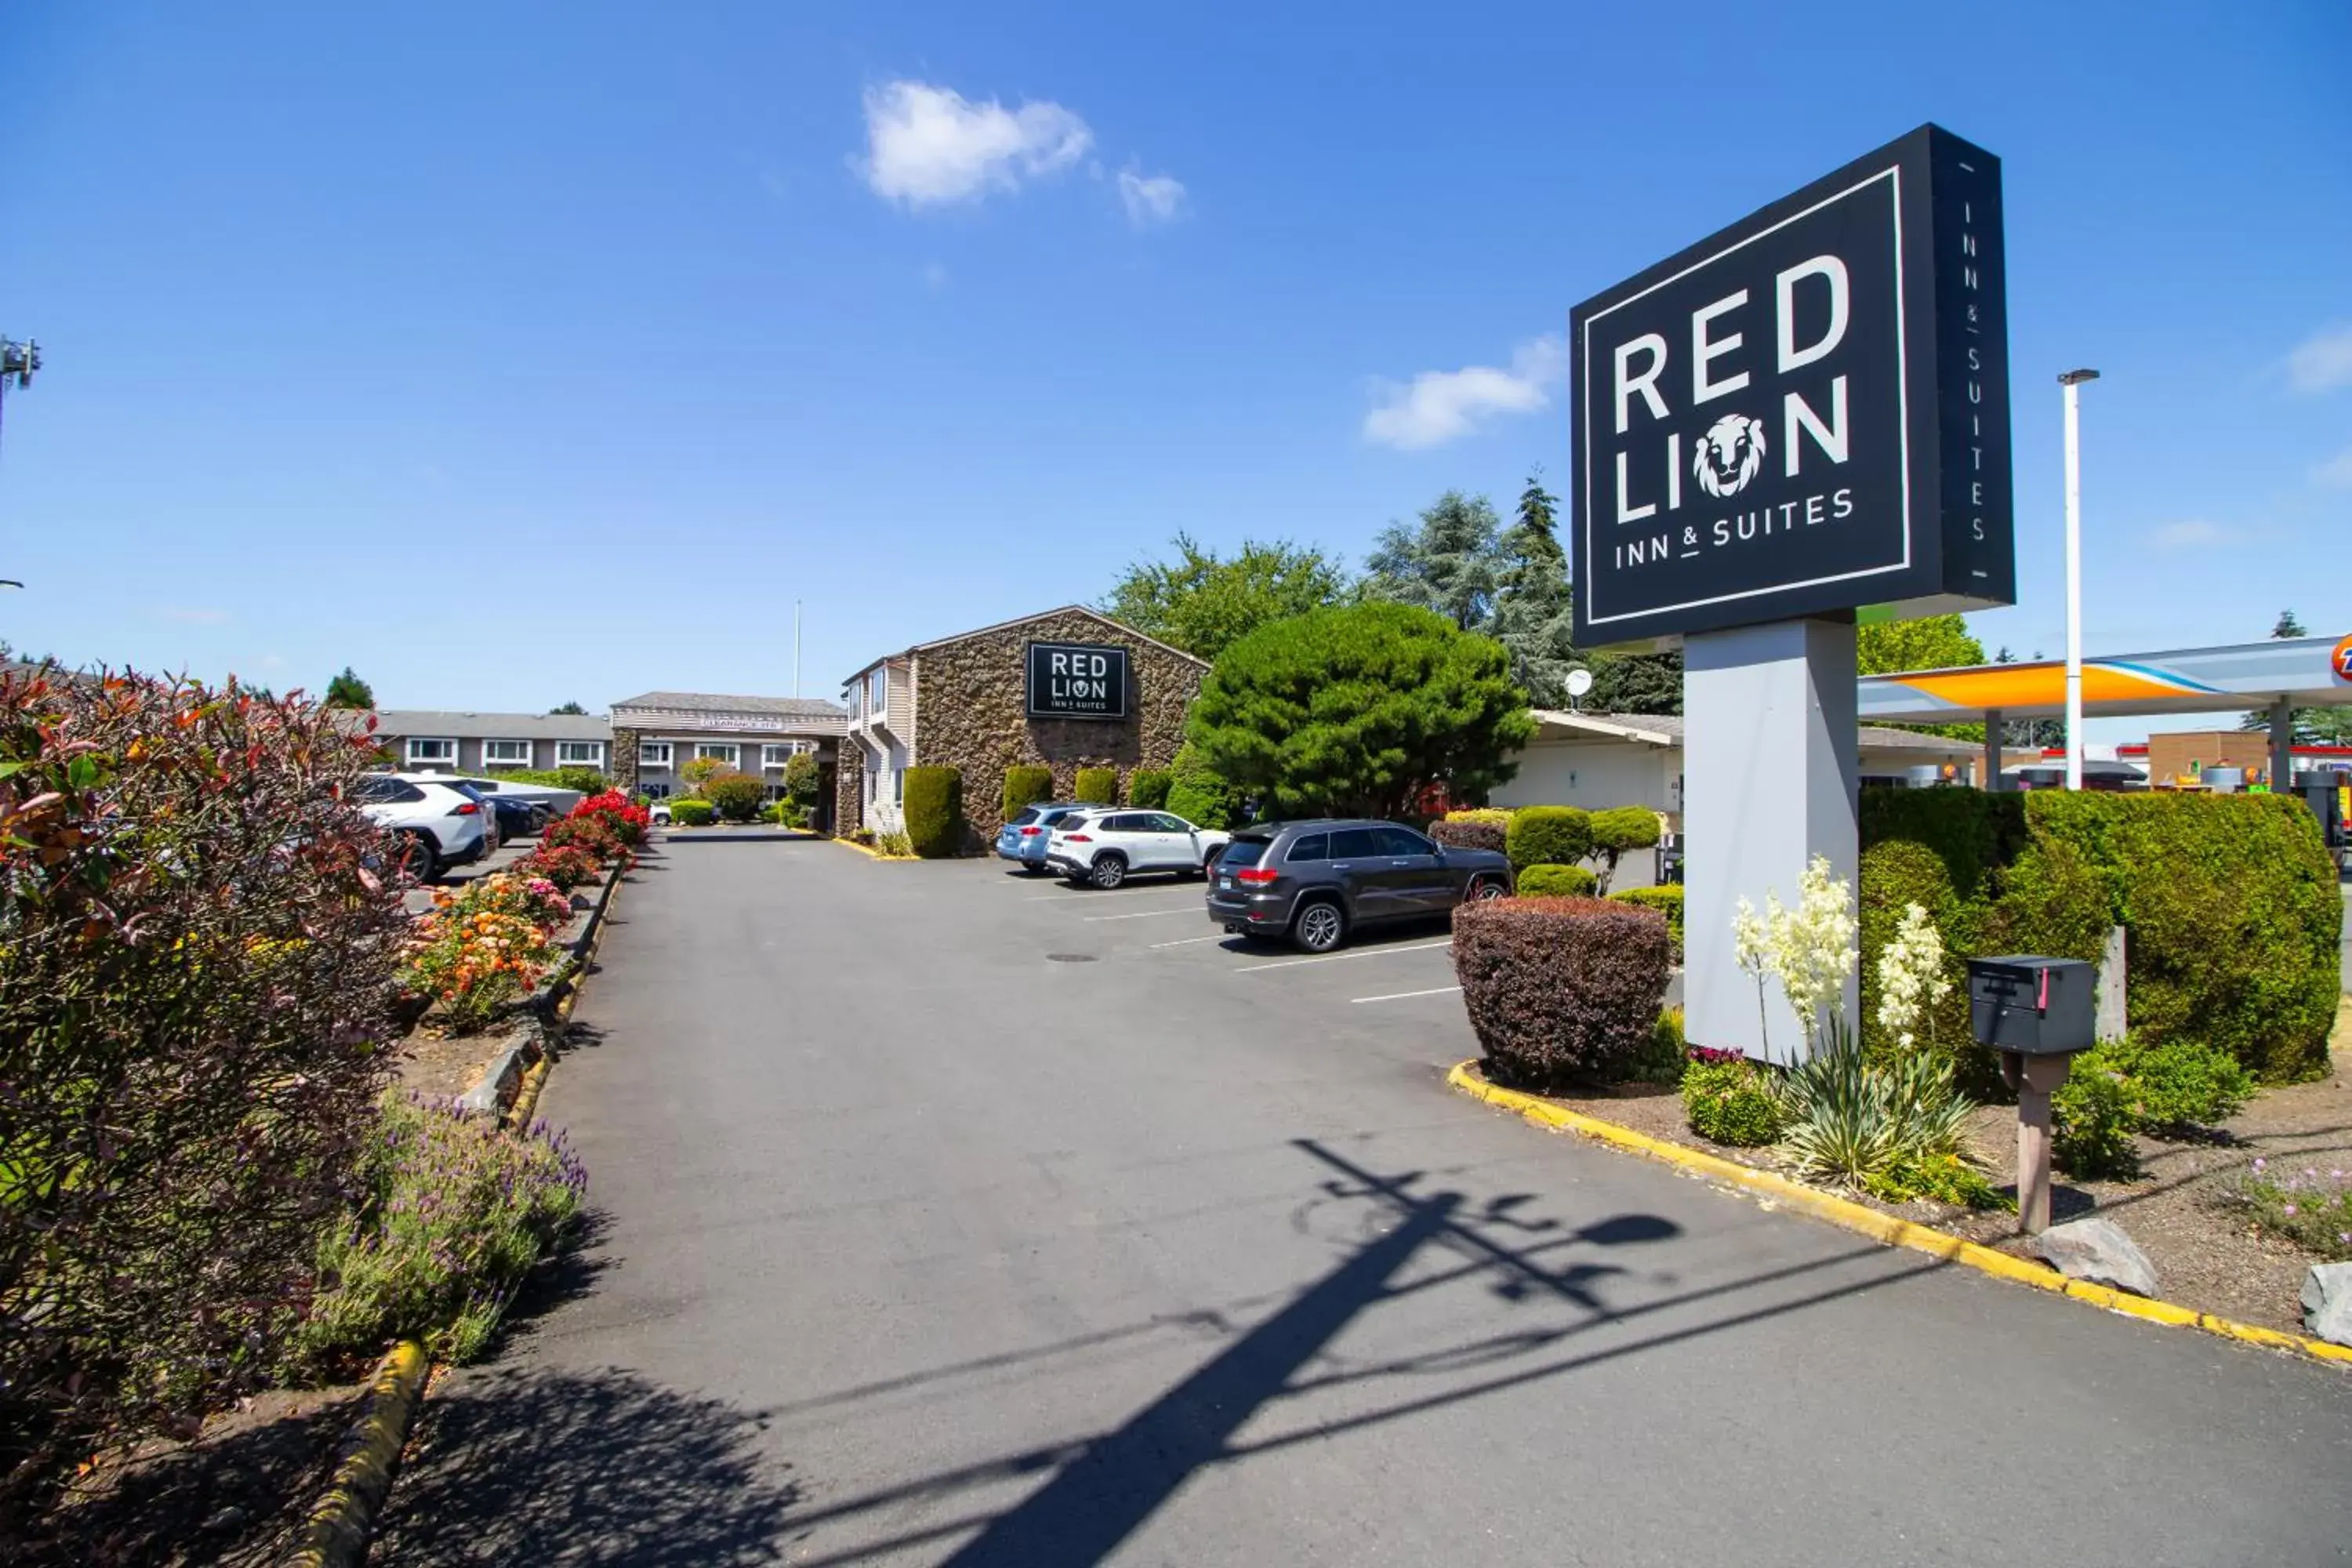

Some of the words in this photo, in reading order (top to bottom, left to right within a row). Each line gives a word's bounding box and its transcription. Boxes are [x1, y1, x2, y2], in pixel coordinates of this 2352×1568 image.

[1964, 201, 1977, 289] INN
[1615, 255, 1849, 434] RED
[1966, 303, 1979, 325] &
[1969, 347, 1984, 540] SUITES
[1617, 535, 1668, 569] INN
[1682, 525, 1699, 547] &
[1713, 489, 1853, 544] SUITES
[1051, 653, 1106, 677] RED
